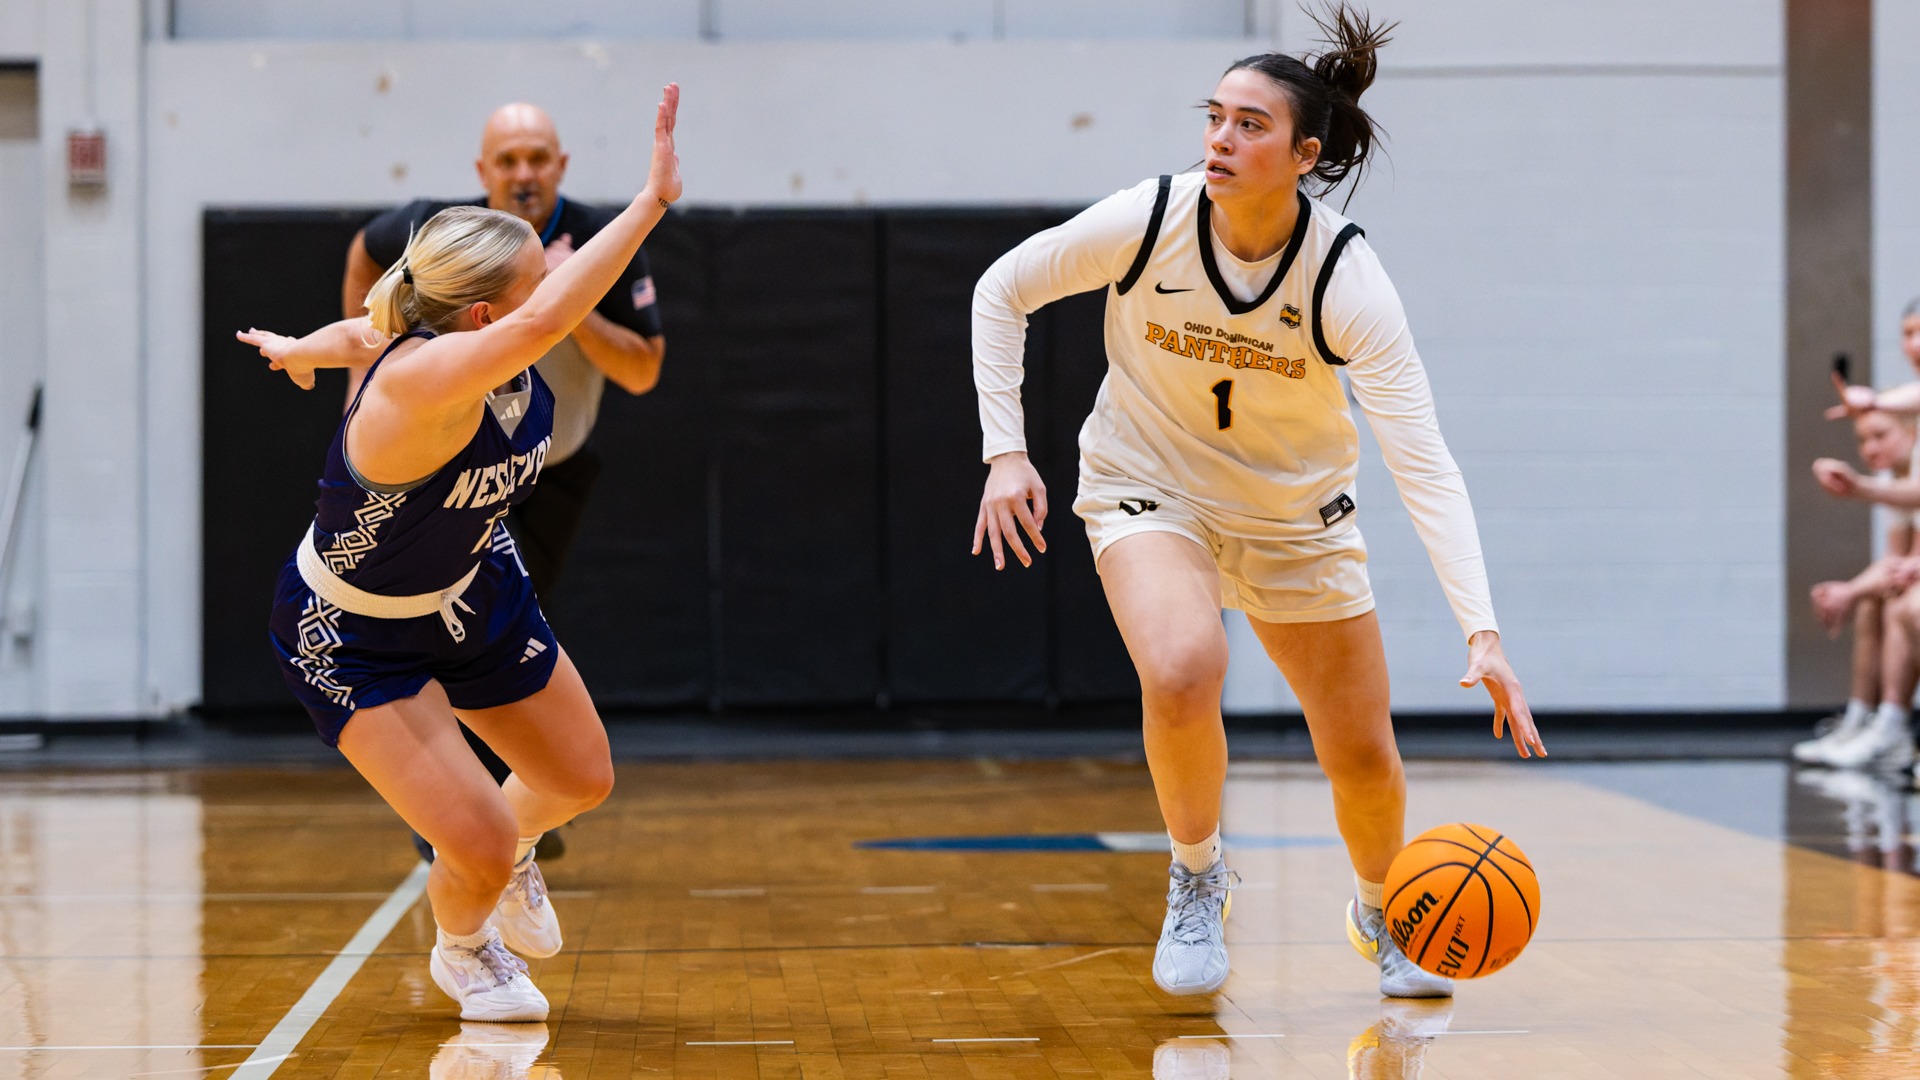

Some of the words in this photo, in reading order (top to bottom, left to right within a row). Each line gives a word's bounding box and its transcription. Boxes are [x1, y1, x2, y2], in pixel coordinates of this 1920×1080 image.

[1145, 321, 1306, 380] PANTHERS
[1184, 321, 1213, 335] OHIO
[1216, 328, 1274, 352] DOMINICAN
[1210, 377, 1235, 432] 1
[1341, 499, 1352, 510] XL
[1390, 891, 1440, 957] ilson
